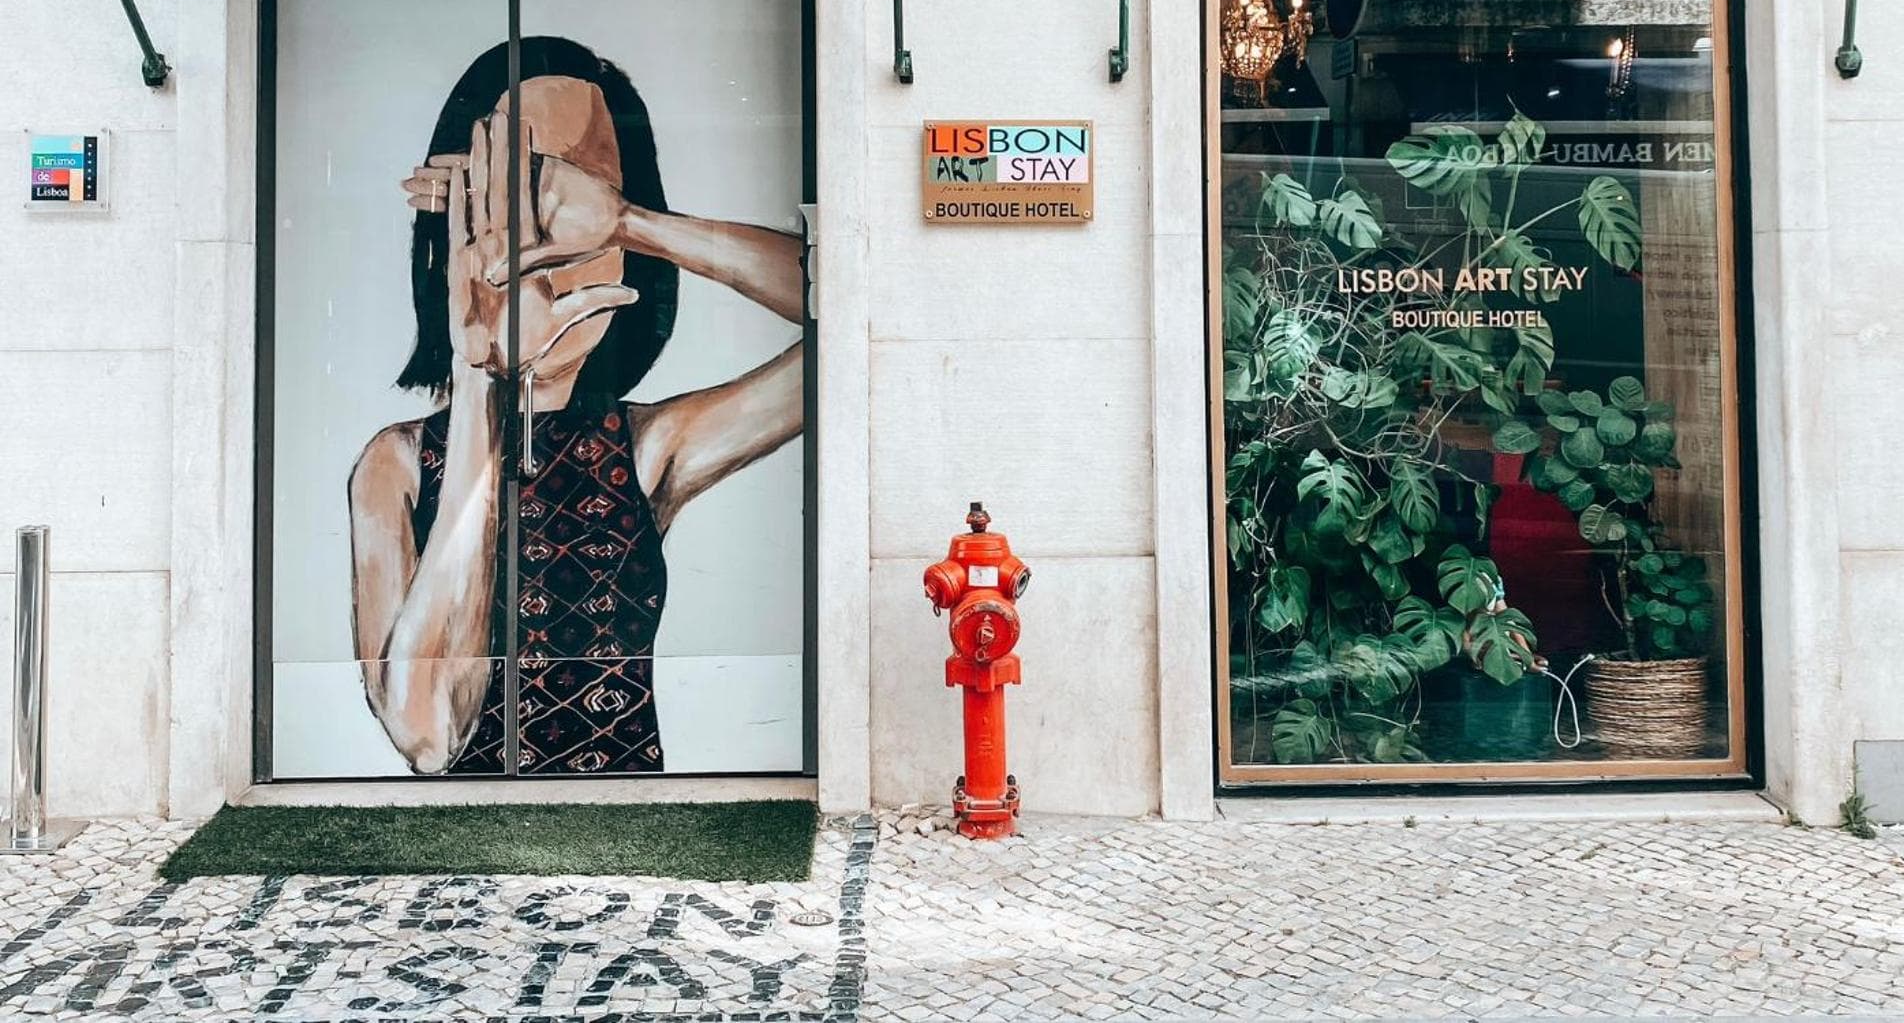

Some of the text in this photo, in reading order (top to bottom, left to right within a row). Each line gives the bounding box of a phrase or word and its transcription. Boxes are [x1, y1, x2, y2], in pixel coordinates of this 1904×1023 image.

[931, 128, 1086, 154] LISBON
[36, 156, 76, 166] Turismo
[937, 156, 1076, 183] ART STAY
[37, 171, 50, 182] de
[36, 187, 68, 197] Lisboa
[935, 202, 1080, 218] BOUTIQUE HOTEL
[1338, 266, 1589, 294] LISBON ART STAY
[1392, 309, 1544, 329] BOUTIQUE HOTEL
[112, 873, 778, 940] LISBON
[345, 941, 818, 1013] STAY
